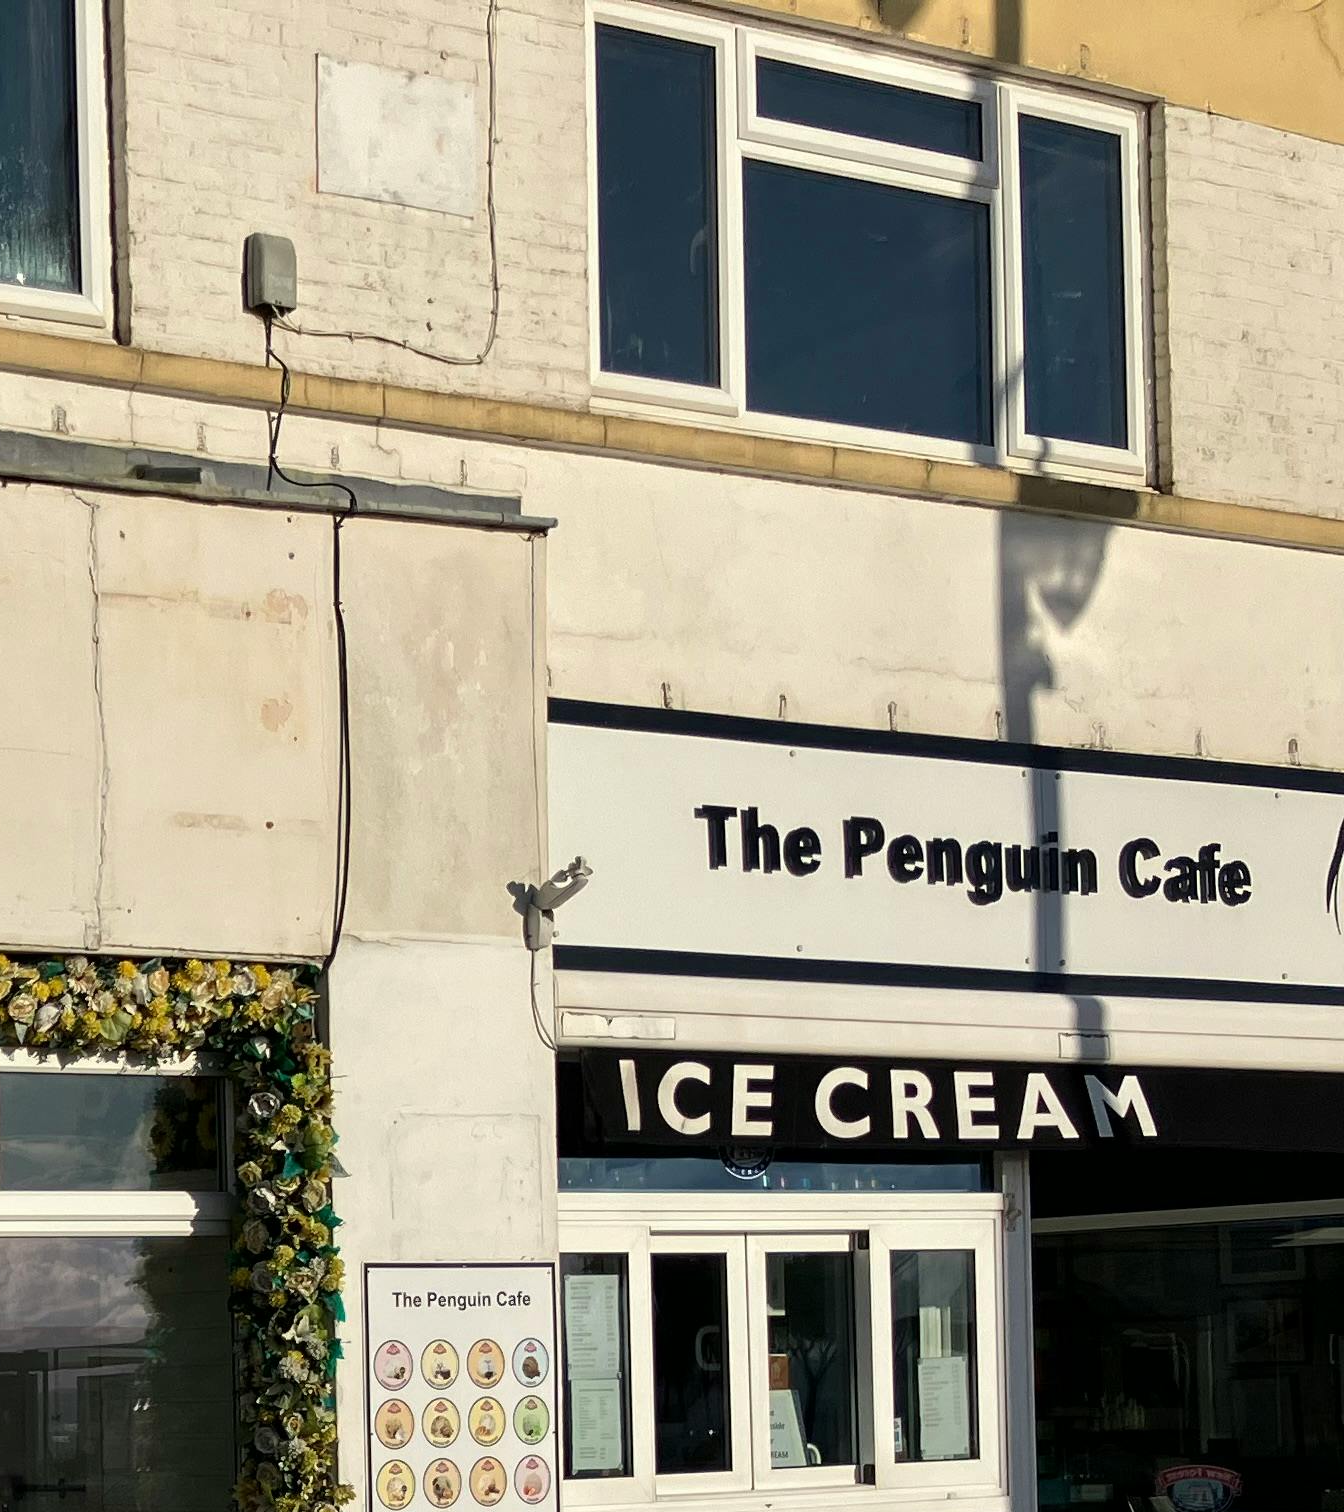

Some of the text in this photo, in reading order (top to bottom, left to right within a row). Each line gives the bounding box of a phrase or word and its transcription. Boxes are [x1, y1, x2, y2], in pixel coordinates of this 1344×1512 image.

[694, 804, 1254, 907] The Penguin Cafe
[618, 1058, 1159, 1140] ICE CREAM
[392, 1291, 531, 1311] The Penguin Cafe
